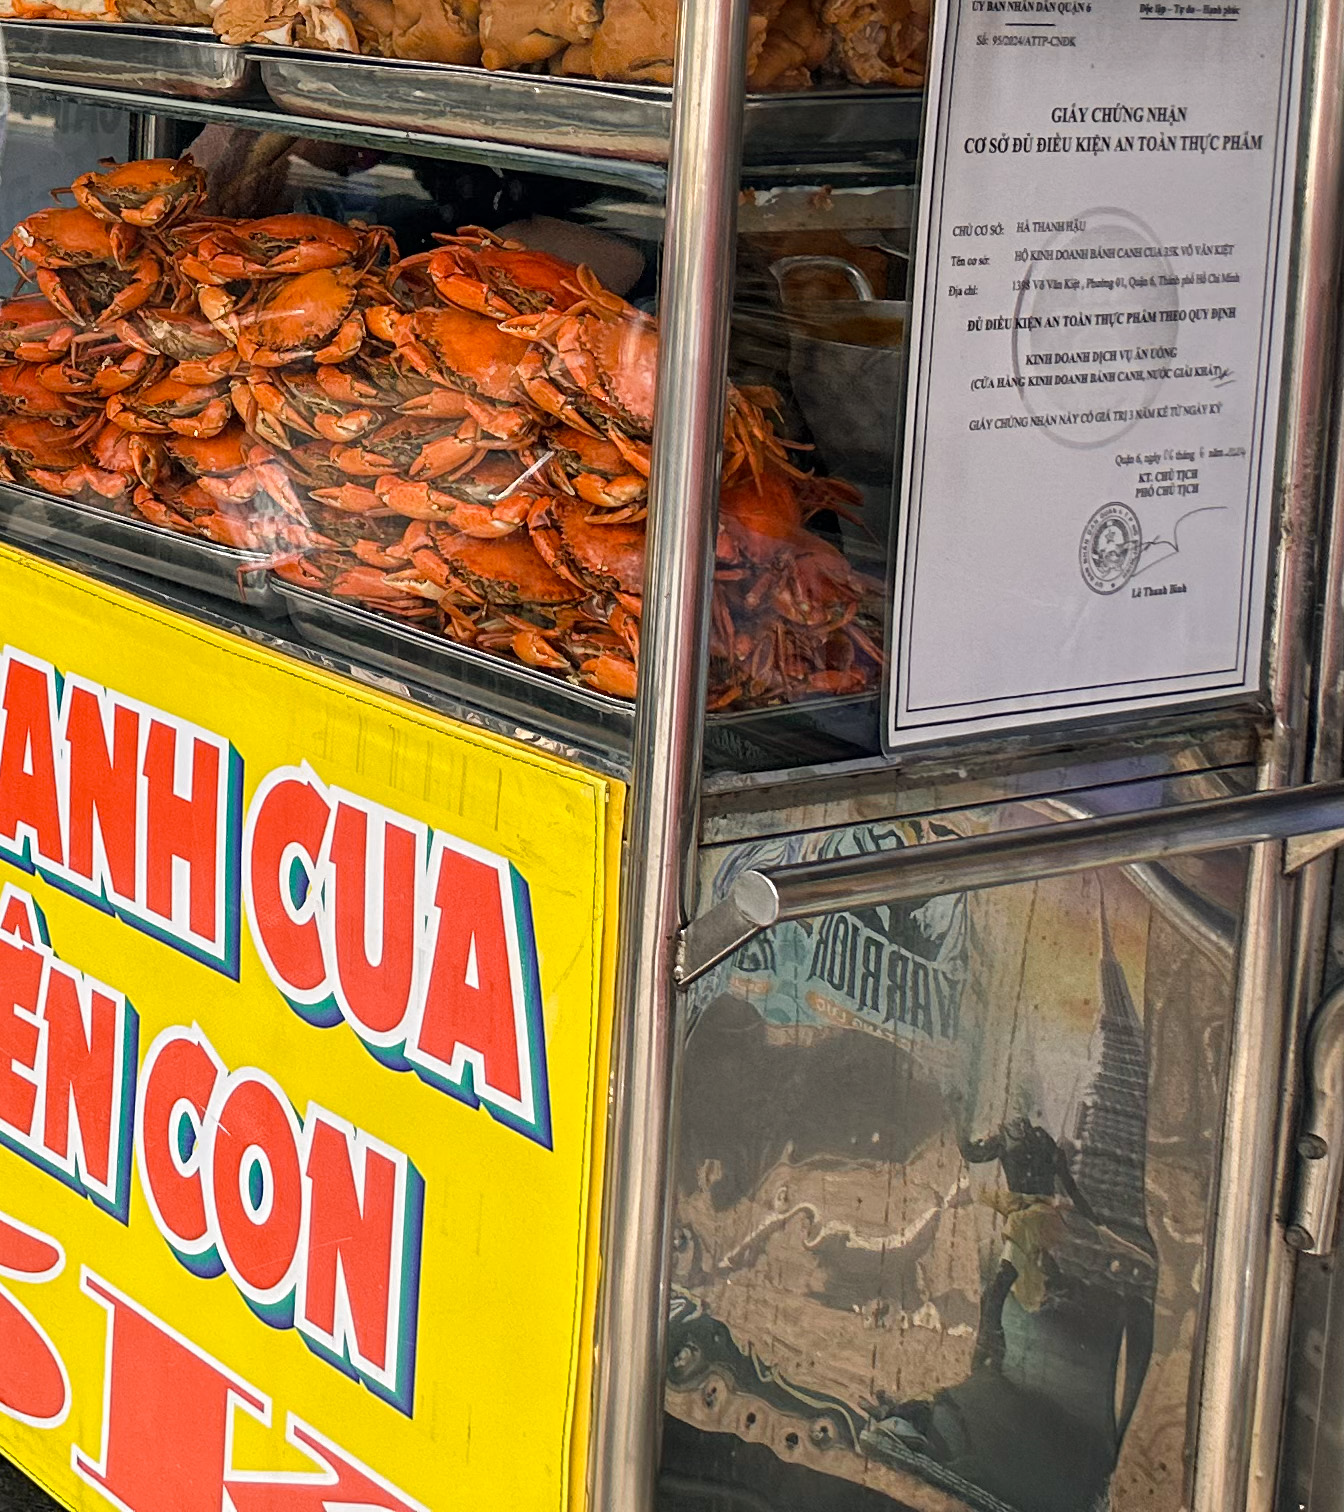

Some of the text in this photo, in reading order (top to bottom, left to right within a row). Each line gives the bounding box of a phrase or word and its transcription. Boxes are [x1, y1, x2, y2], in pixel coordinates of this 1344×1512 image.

[1051, 102, 1188, 127] GIẤY CHỨNG NHẬN
[964, 131, 1264, 157] CƠ SỞ ĐỦ ĐIỀU KIỆN AN TOÀN THỰC PHẨM
[967, 307, 1237, 332] ĐỦ ĐIỀU KIỆN AN TOÀN THỰC PHẨM THEO QUY ĐỊNH
[245, 762, 537, 1118] CUA
[136, 1023, 410, 1390] CON
